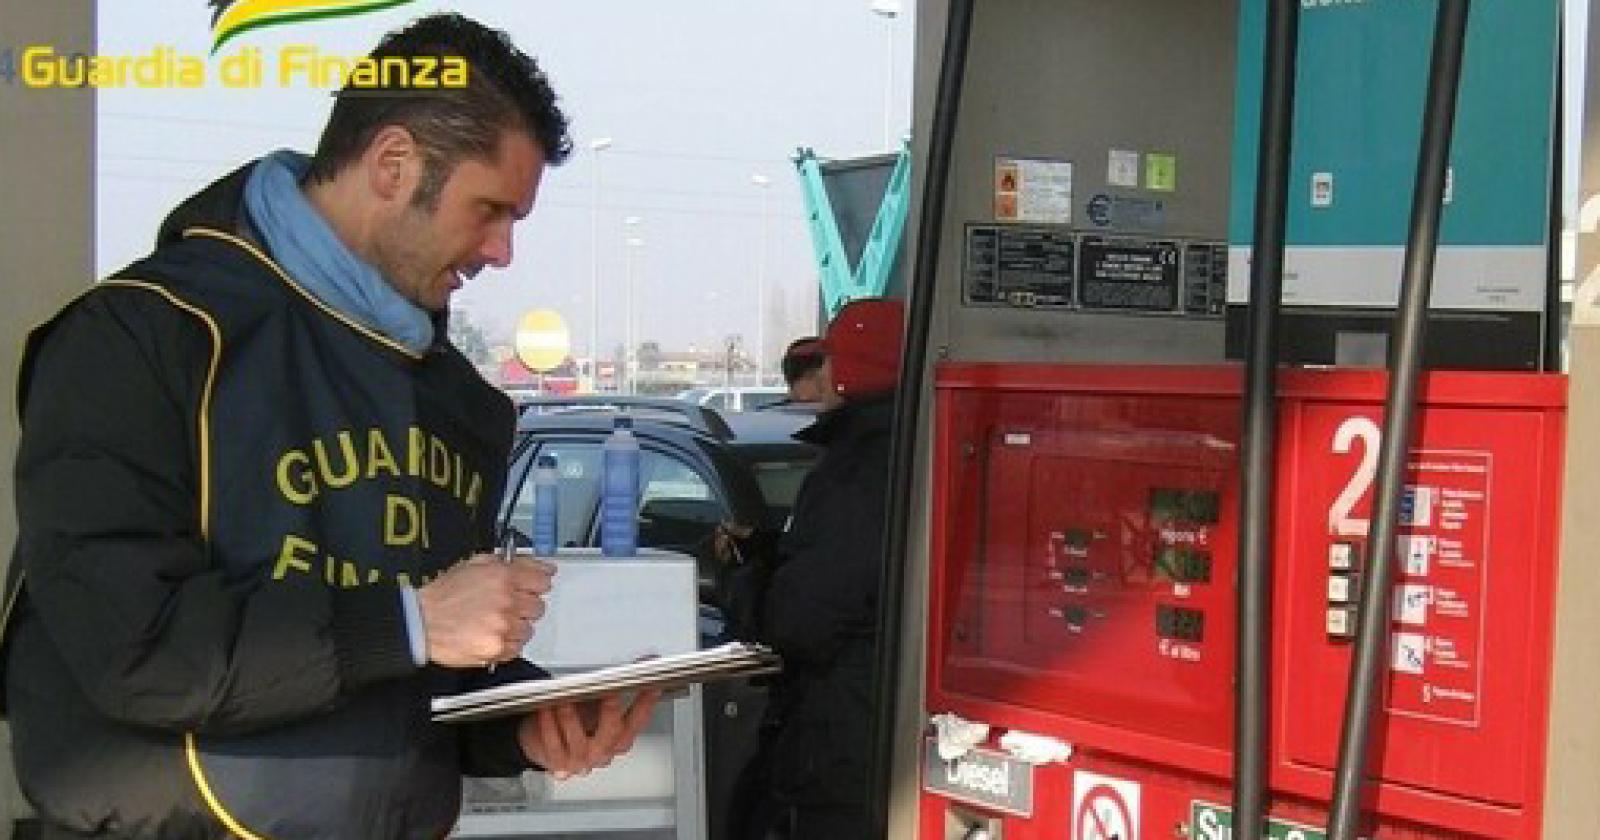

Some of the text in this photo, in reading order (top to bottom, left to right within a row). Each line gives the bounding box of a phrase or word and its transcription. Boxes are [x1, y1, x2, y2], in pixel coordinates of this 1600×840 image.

[1329, 416, 1381, 536] 2
[386, 493, 430, 549] DI
[946, 756, 1009, 794] Diesel
